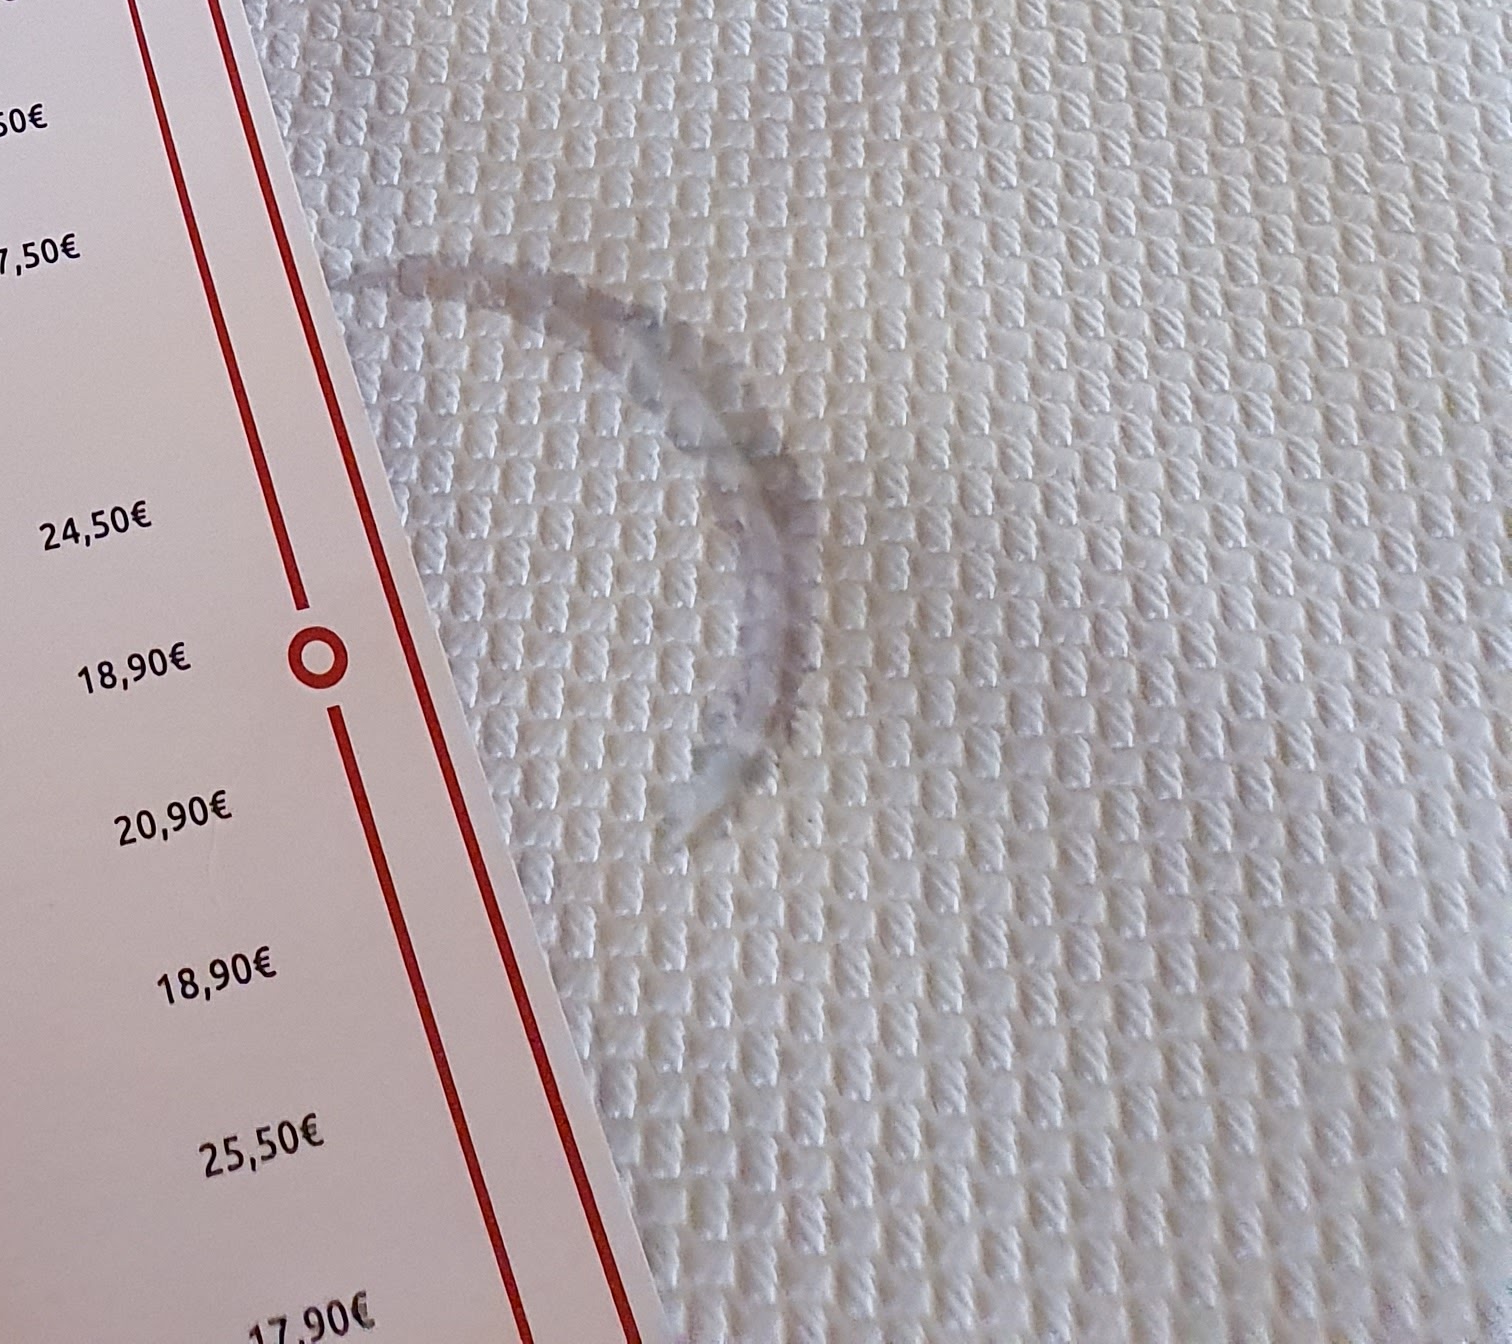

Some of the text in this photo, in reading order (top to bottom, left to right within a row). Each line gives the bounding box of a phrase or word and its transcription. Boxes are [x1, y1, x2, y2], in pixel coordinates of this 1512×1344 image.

[38, 499, 153, 552] 24,50€
[77, 641, 192, 695] 18,90€
[113, 789, 233, 847] 20,90€
[156, 945, 278, 1006] 18,90€
[198, 1112, 325, 1179] 25,50€
